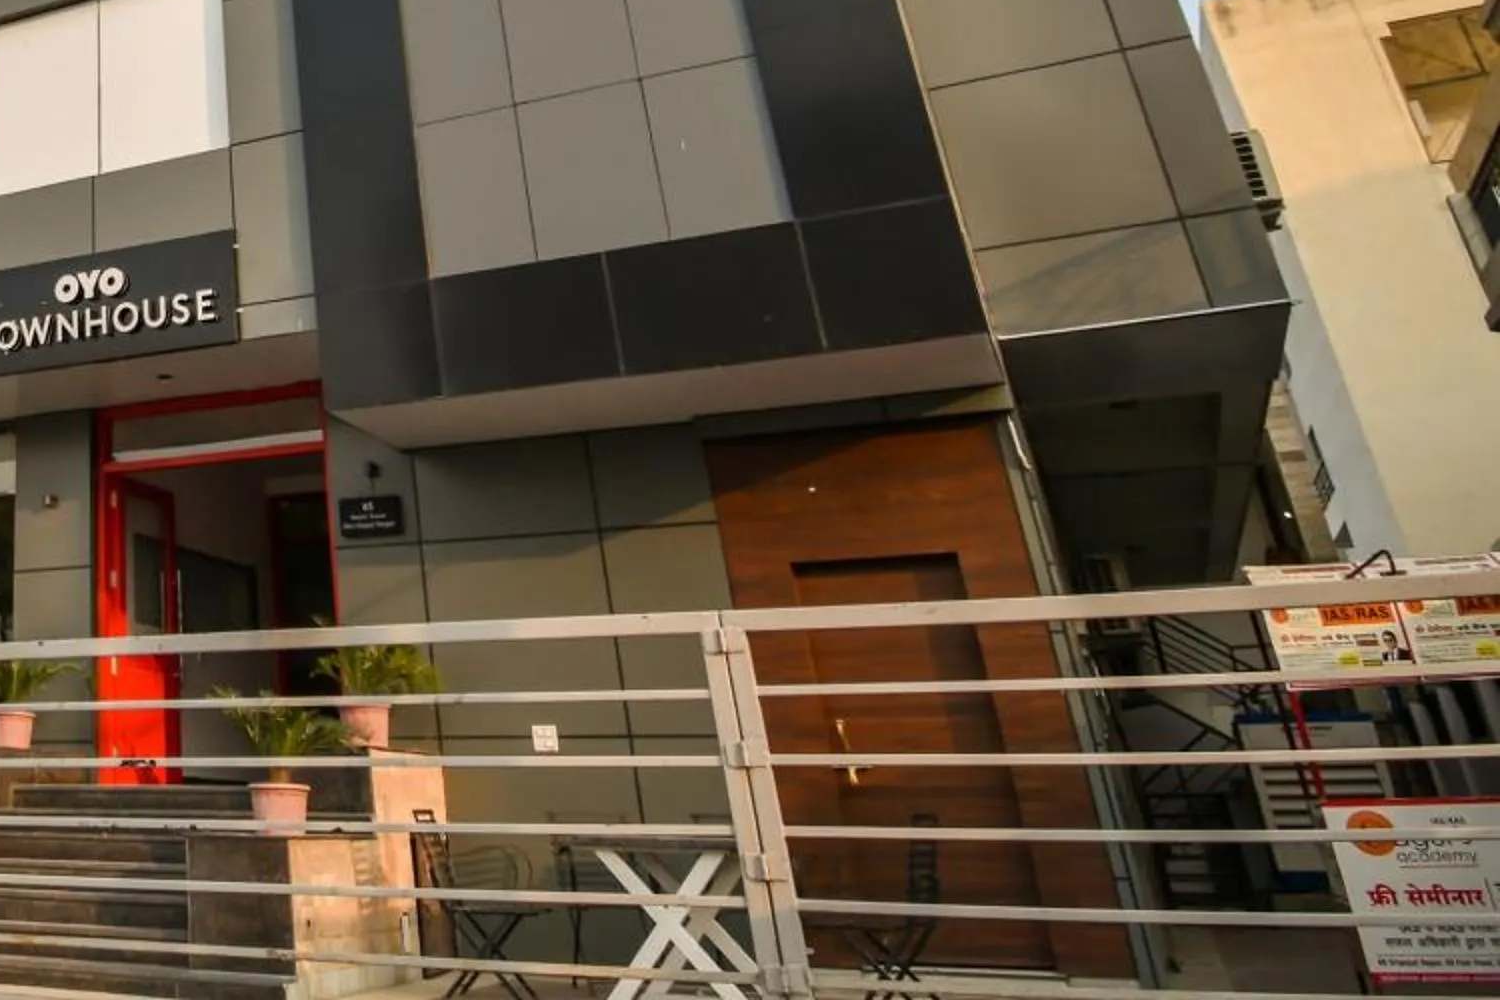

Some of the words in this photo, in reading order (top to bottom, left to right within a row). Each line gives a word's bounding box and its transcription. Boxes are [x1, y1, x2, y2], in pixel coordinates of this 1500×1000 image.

[54, 266, 129, 304] OYO
[1396, 850, 1478, 865] academy
[1366, 882, 1399, 907] फ्री
